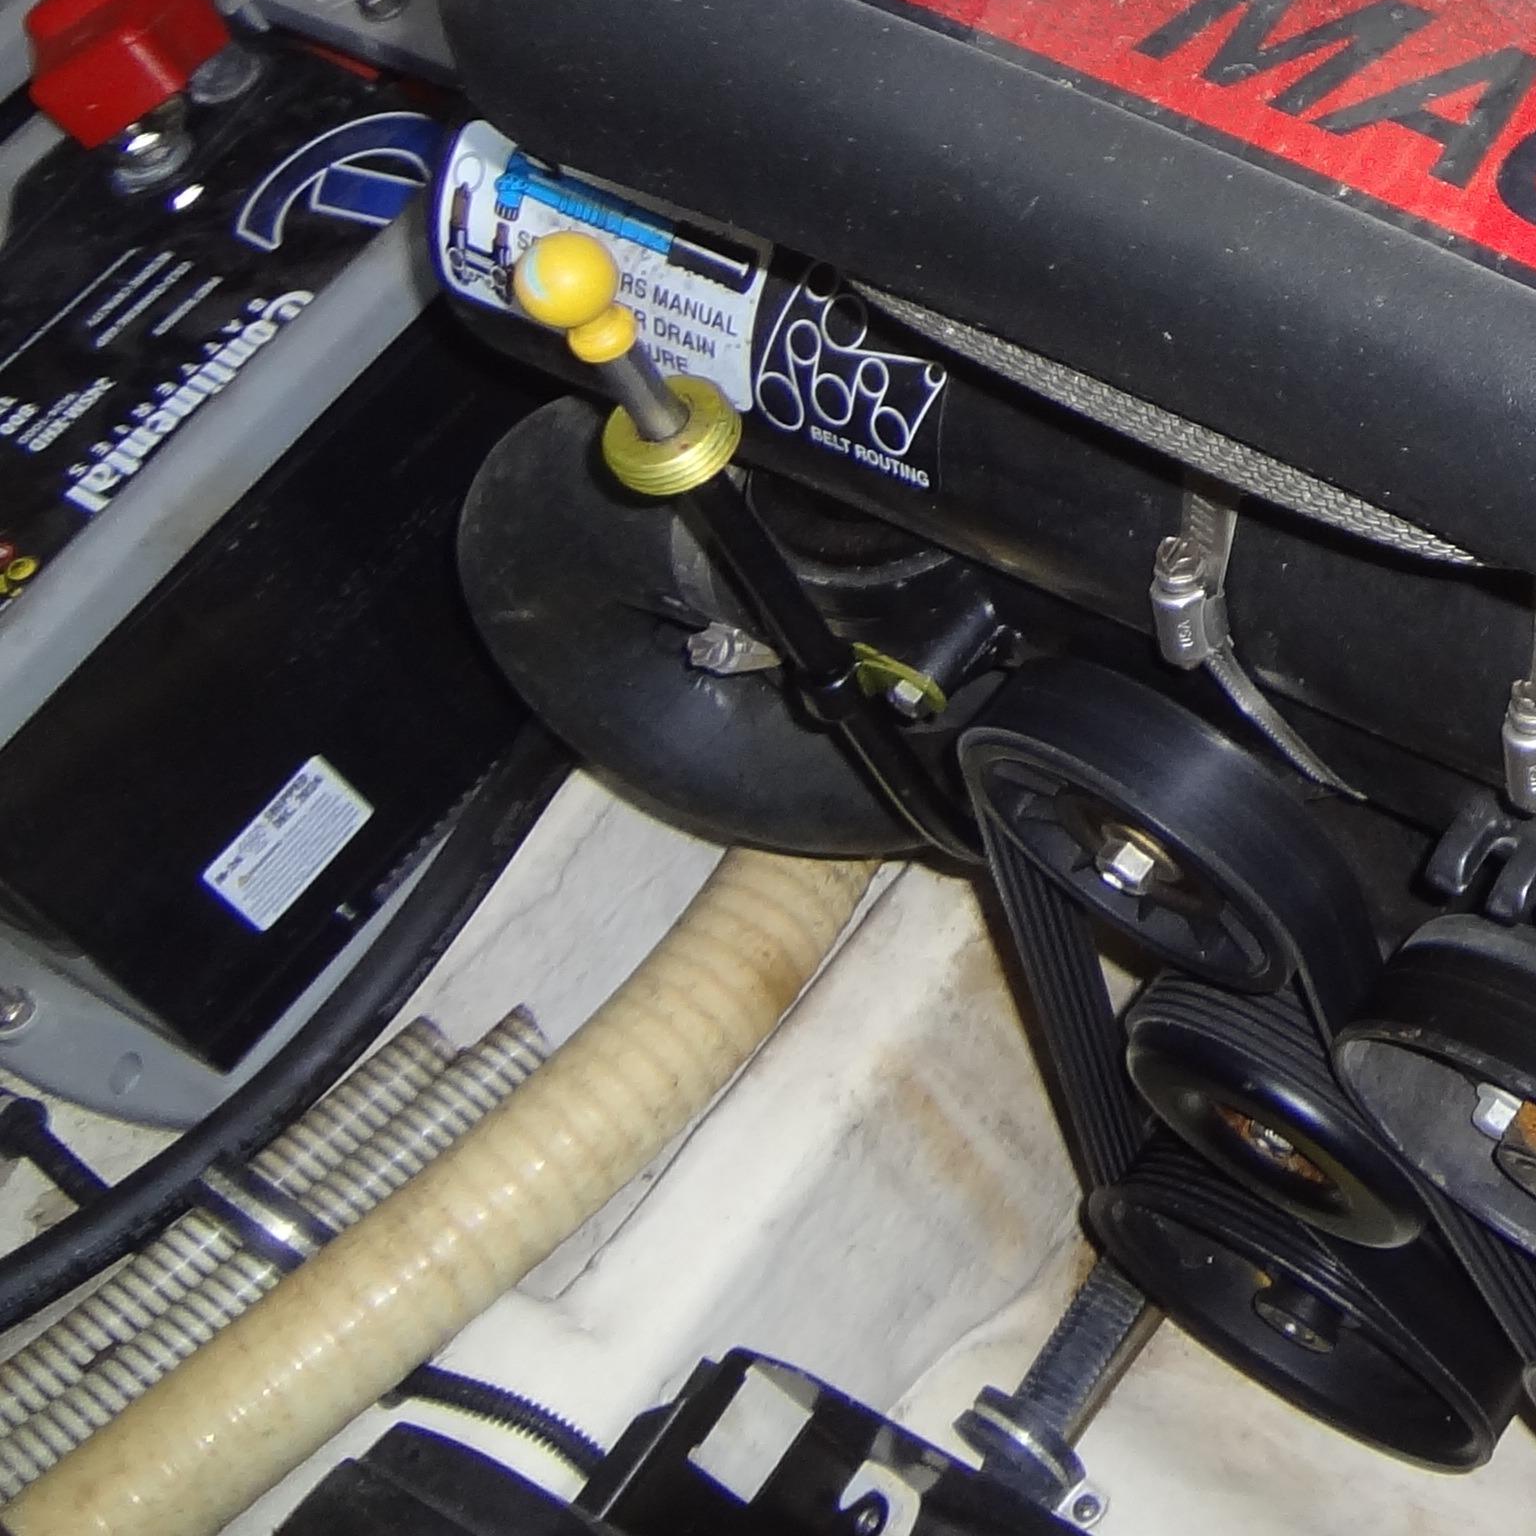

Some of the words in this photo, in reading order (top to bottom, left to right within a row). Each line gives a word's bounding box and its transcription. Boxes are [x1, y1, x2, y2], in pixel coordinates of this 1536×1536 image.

[652, 287, 739, 337] MANUAL
[652, 318, 718, 358] DRAIN
[63, 294, 269, 482] BATTERIES
[63, 289, 315, 516] Continental
[810, 425, 850, 461] BELT
[854, 442, 931, 488] ROUTING
